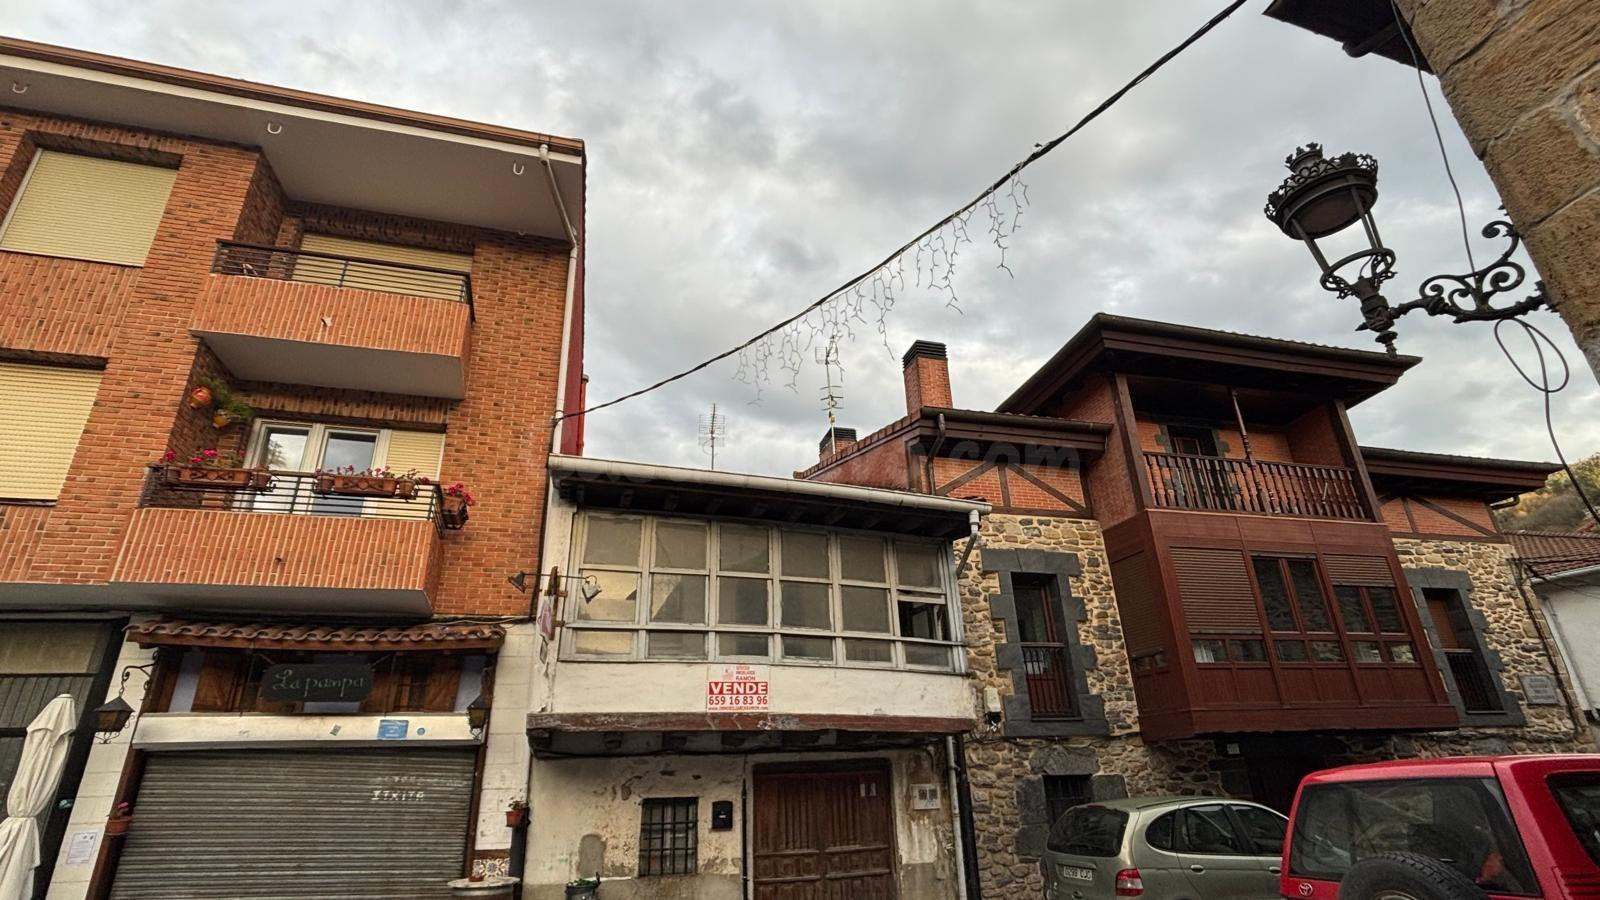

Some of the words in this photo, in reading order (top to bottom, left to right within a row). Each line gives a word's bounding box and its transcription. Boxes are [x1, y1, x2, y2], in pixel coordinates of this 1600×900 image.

[272, 670, 300, 690] La
[303, 678, 364, 697] pampa
[710, 683, 767, 694] VENDE
[709, 696, 725, 705] 659
[729, 696, 740, 705] 16
[742, 696, 754, 705] 83
[756, 696, 768, 705] 96
